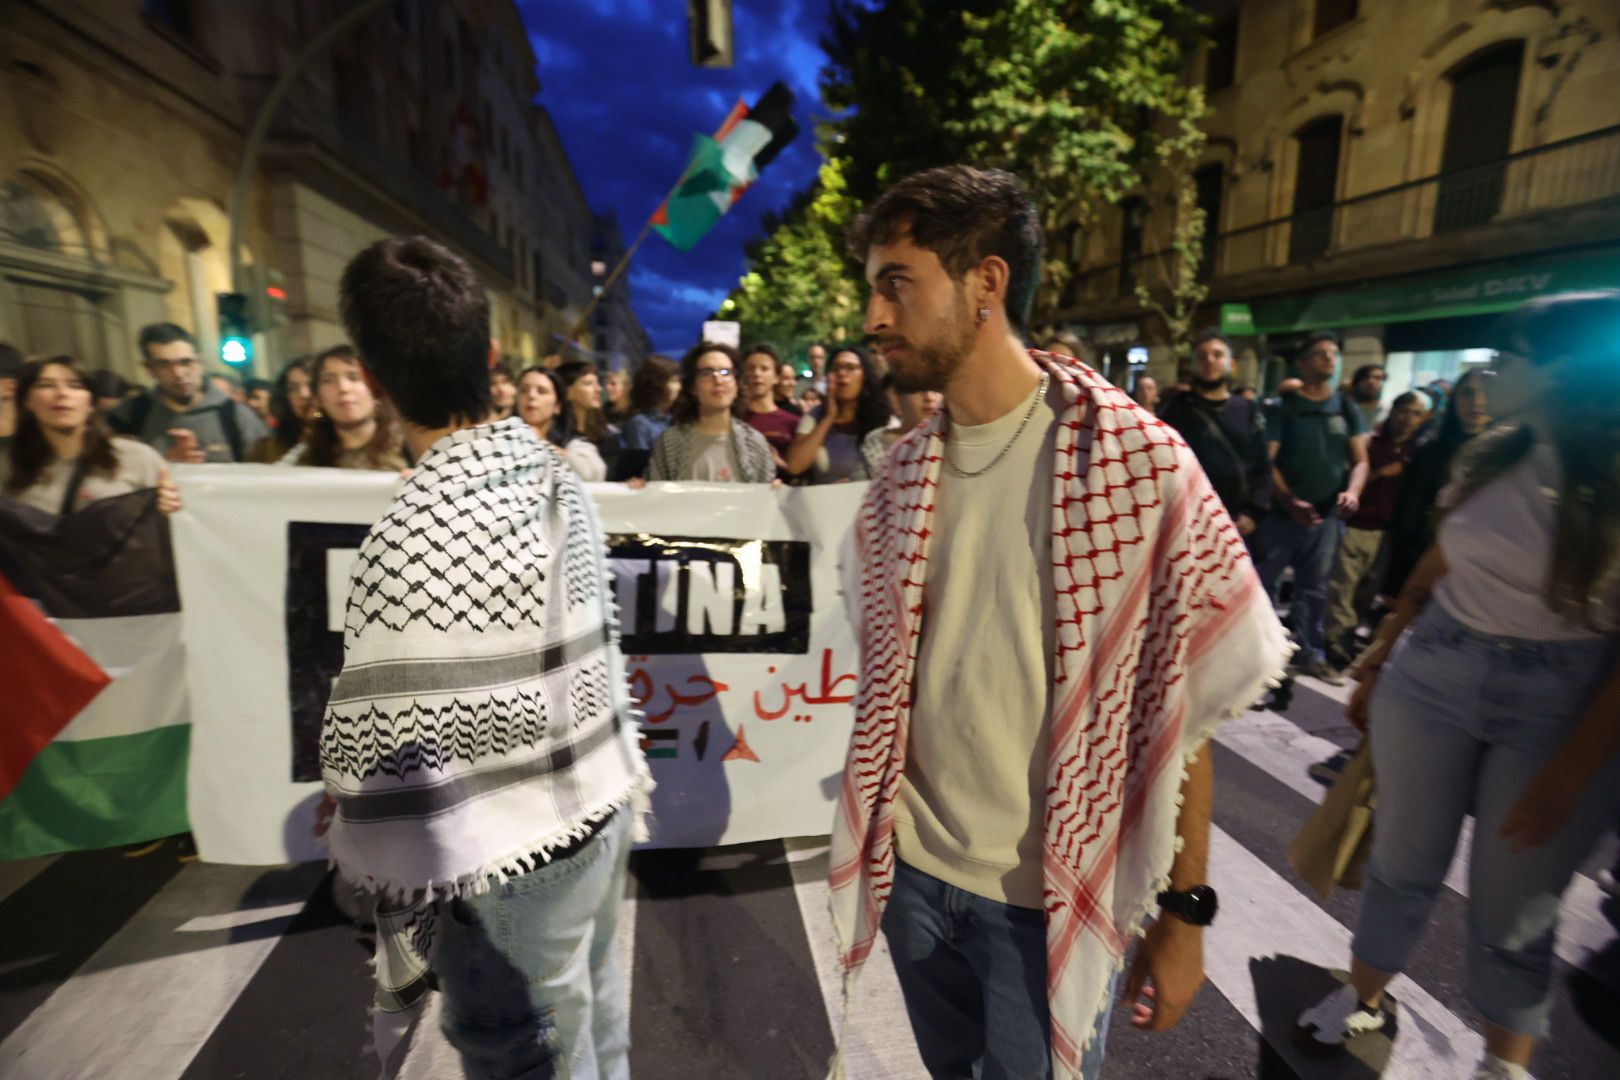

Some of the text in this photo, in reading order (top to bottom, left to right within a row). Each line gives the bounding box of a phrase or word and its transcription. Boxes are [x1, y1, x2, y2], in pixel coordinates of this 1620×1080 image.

[1483, 273, 1553, 297] DKV
[610, 558, 787, 636] TINA
[753, 648, 858, 722] طين
